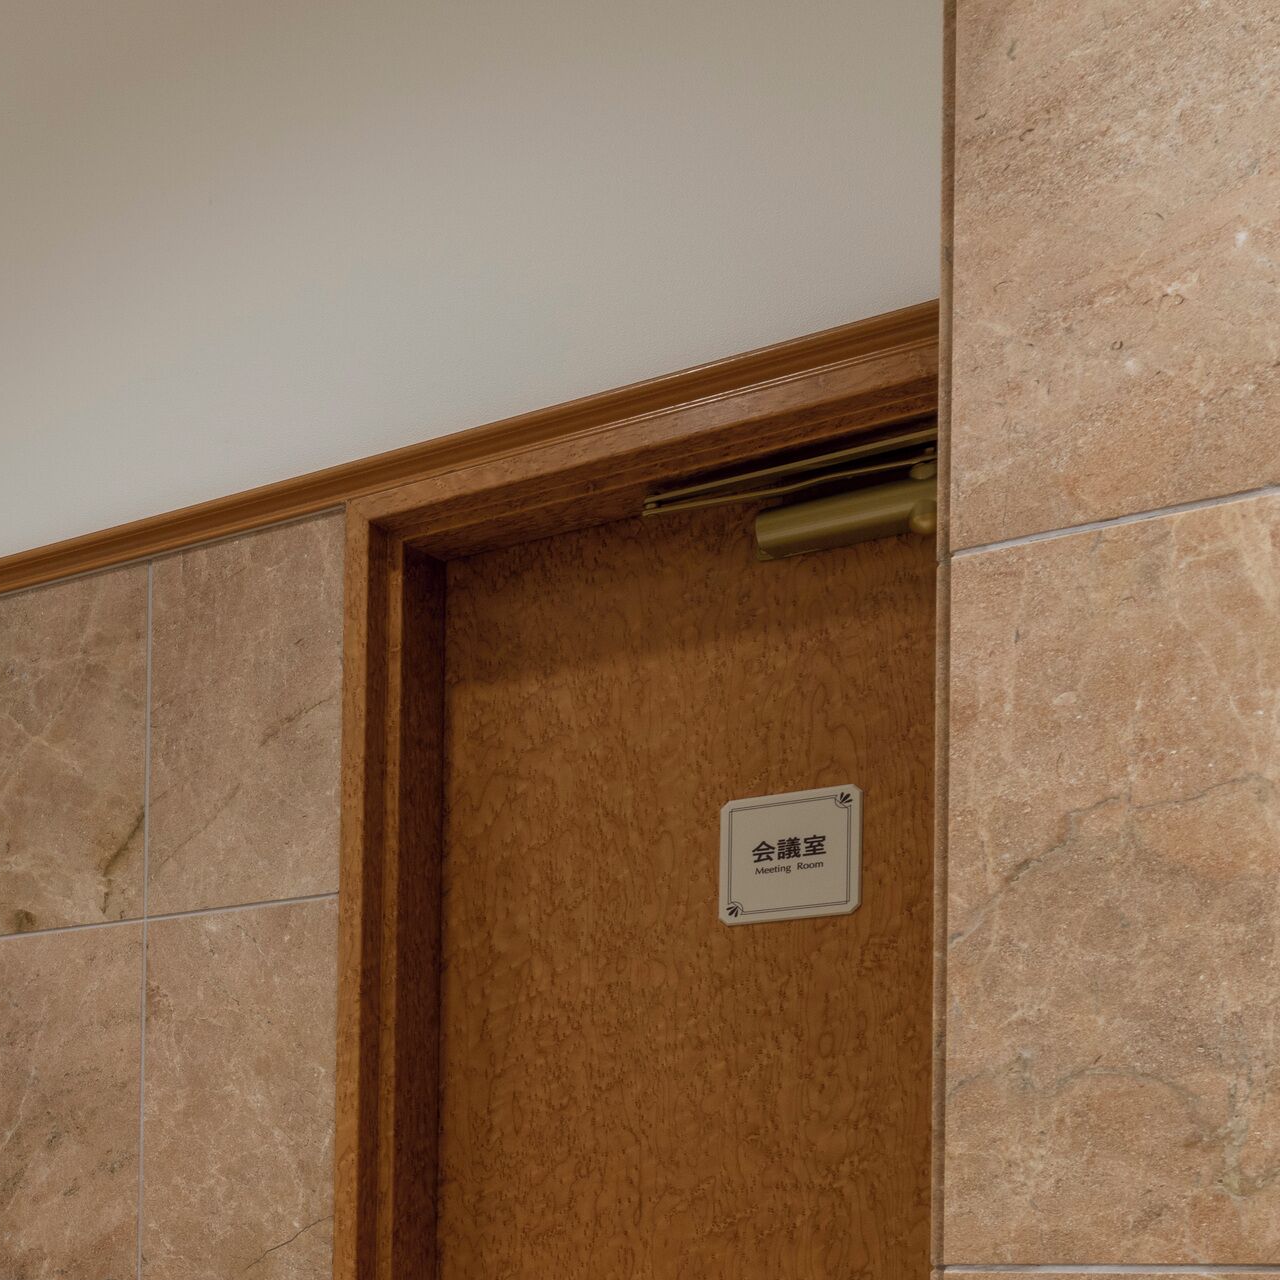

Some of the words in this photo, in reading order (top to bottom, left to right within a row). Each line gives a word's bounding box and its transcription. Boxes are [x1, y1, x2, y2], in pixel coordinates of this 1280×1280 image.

[751, 835, 826, 863] 会議室
[754, 864, 792, 875] Meeting
[797, 860, 824, 870] Room
